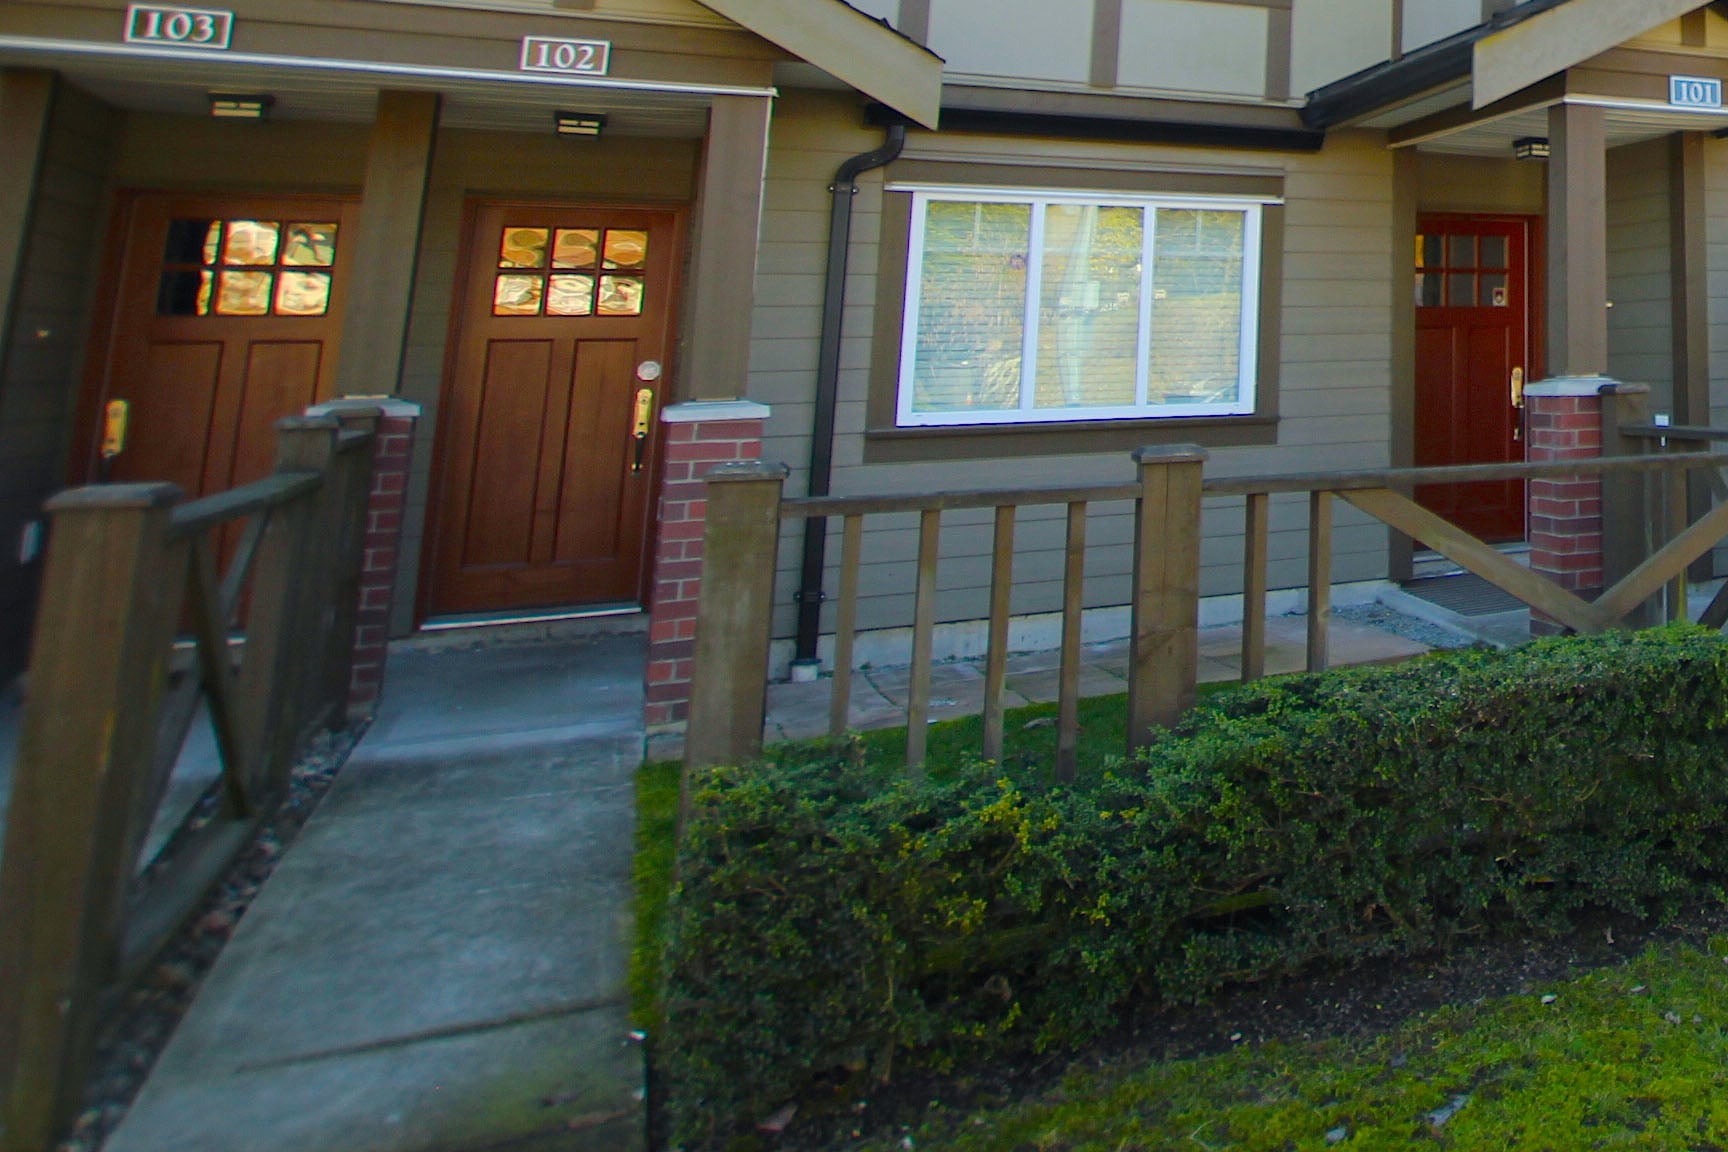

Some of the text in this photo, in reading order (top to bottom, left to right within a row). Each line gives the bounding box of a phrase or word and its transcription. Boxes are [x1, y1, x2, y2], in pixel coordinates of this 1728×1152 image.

[144, 12, 216, 42] 103
[536, 44, 594, 69] 102
[1680, 83, 1712, 104] 101
